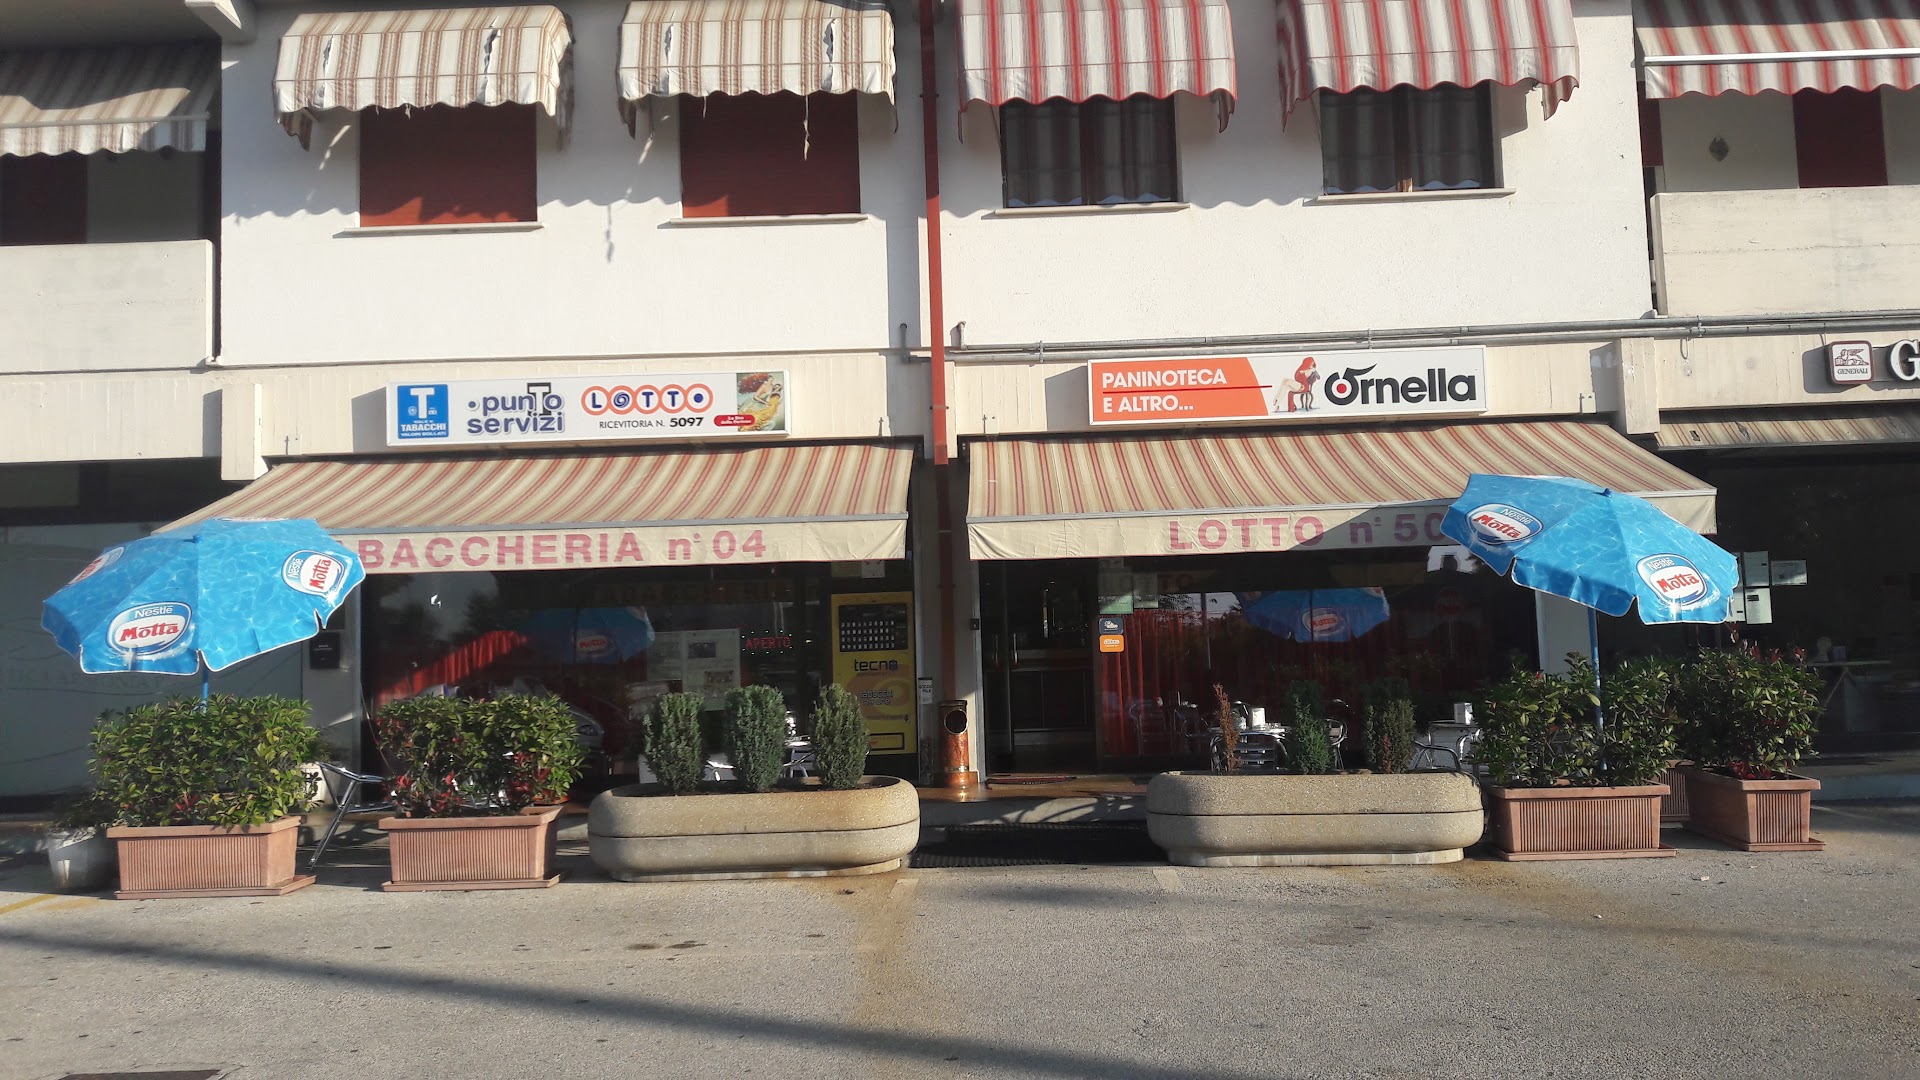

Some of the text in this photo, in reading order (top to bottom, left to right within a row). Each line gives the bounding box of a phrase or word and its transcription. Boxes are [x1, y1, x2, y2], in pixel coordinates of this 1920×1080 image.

[1102, 368, 1228, 388] PANINOTECA
[1324, 363, 1477, 406] Ornella
[410, 387, 435, 419] T
[584, 386, 711, 413] LOTTO
[1103, 395, 1194, 413] E ALTRO...
[400, 423, 447, 431] TABACCHI
[467, 412, 563, 434] servizi
[599, 417, 704, 429] RICEVITORIA N. 5097
[1169, 516, 1324, 550] LOTTO
[1473, 514, 1522, 539] Motta
[357, 532, 644, 569] BACCHERIA
[712, 529, 767, 559] 04
[309, 558, 332, 590] Motta
[1656, 573, 1700, 593] Motta
[119, 622, 179, 642] Motta
[745, 636, 791, 649] APERTO
[854, 659, 898, 672] tecno
